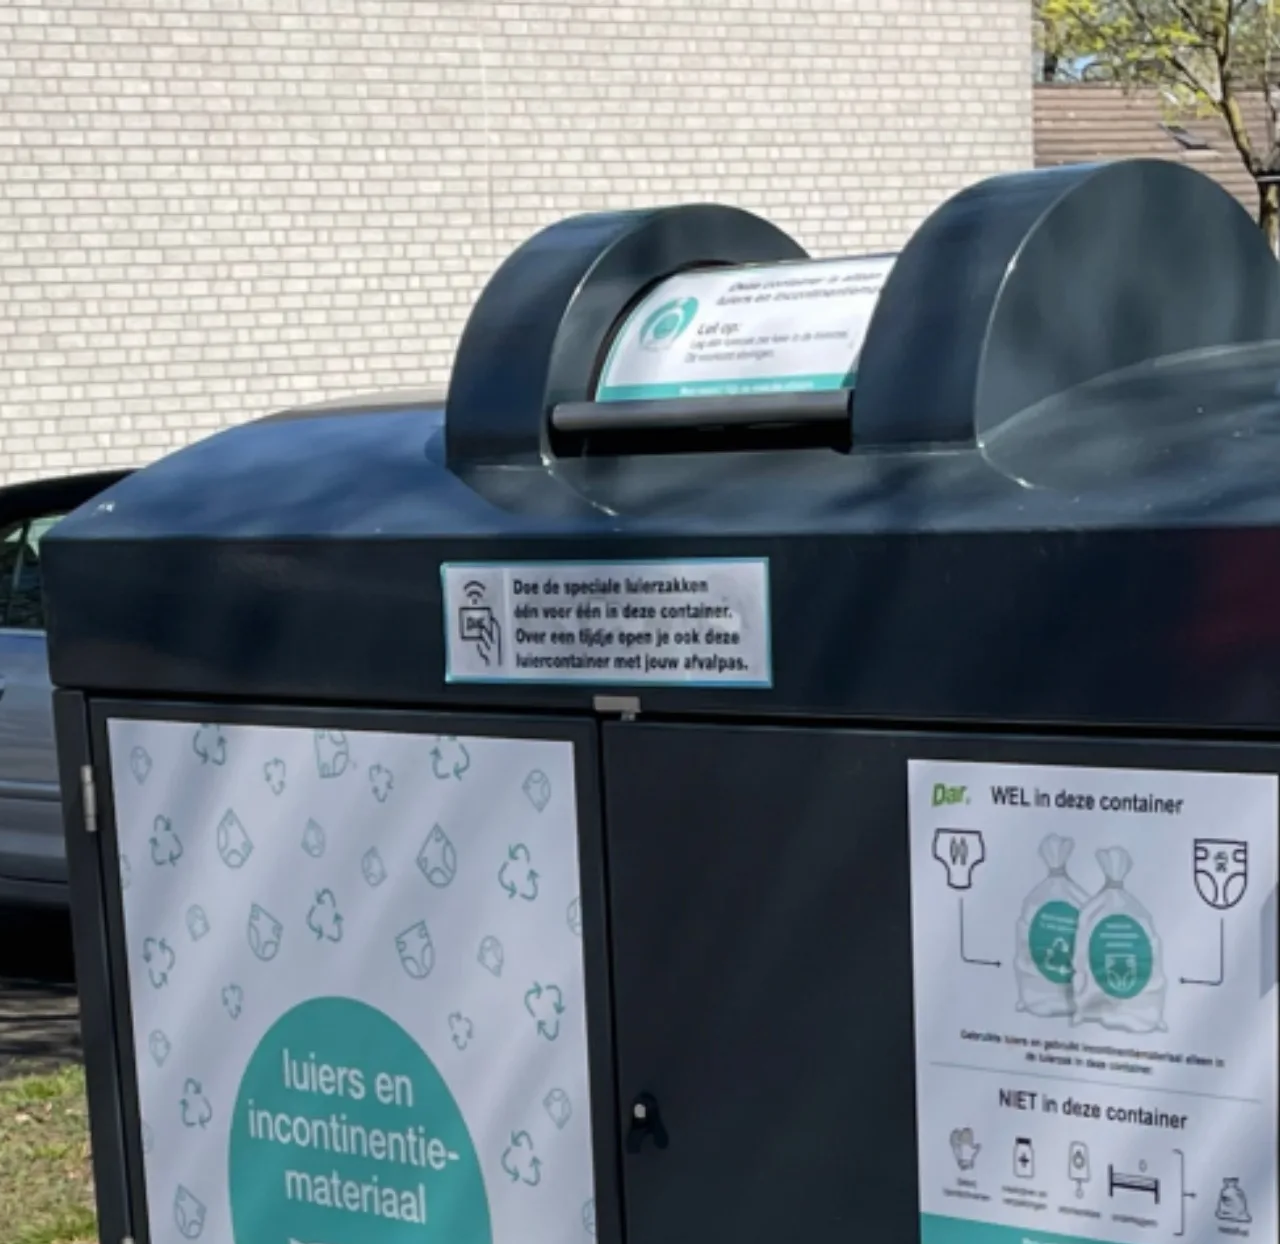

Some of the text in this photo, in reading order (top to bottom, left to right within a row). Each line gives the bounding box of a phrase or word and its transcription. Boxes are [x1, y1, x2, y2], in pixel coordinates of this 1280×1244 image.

[513, 577, 709, 598] Doe de speciale luierzakken
[542, 605, 573, 619] voor
[605, 602, 618, 619] in
[622, 602, 656, 619] deze
[660, 601, 732, 619] container.
[516, 626, 740, 648] Over een tijdje open je ook deze
[516, 651, 748, 674] luiercontainer met jouw afvalpas.
[990, 785, 1184, 815] WEL in deze container
[282, 1048, 414, 1108] luiers en
[999, 1088, 1189, 1130] NIET in deze container
[247, 1099, 460, 1171] incontinentie-
[285, 1169, 427, 1225] materiaal
